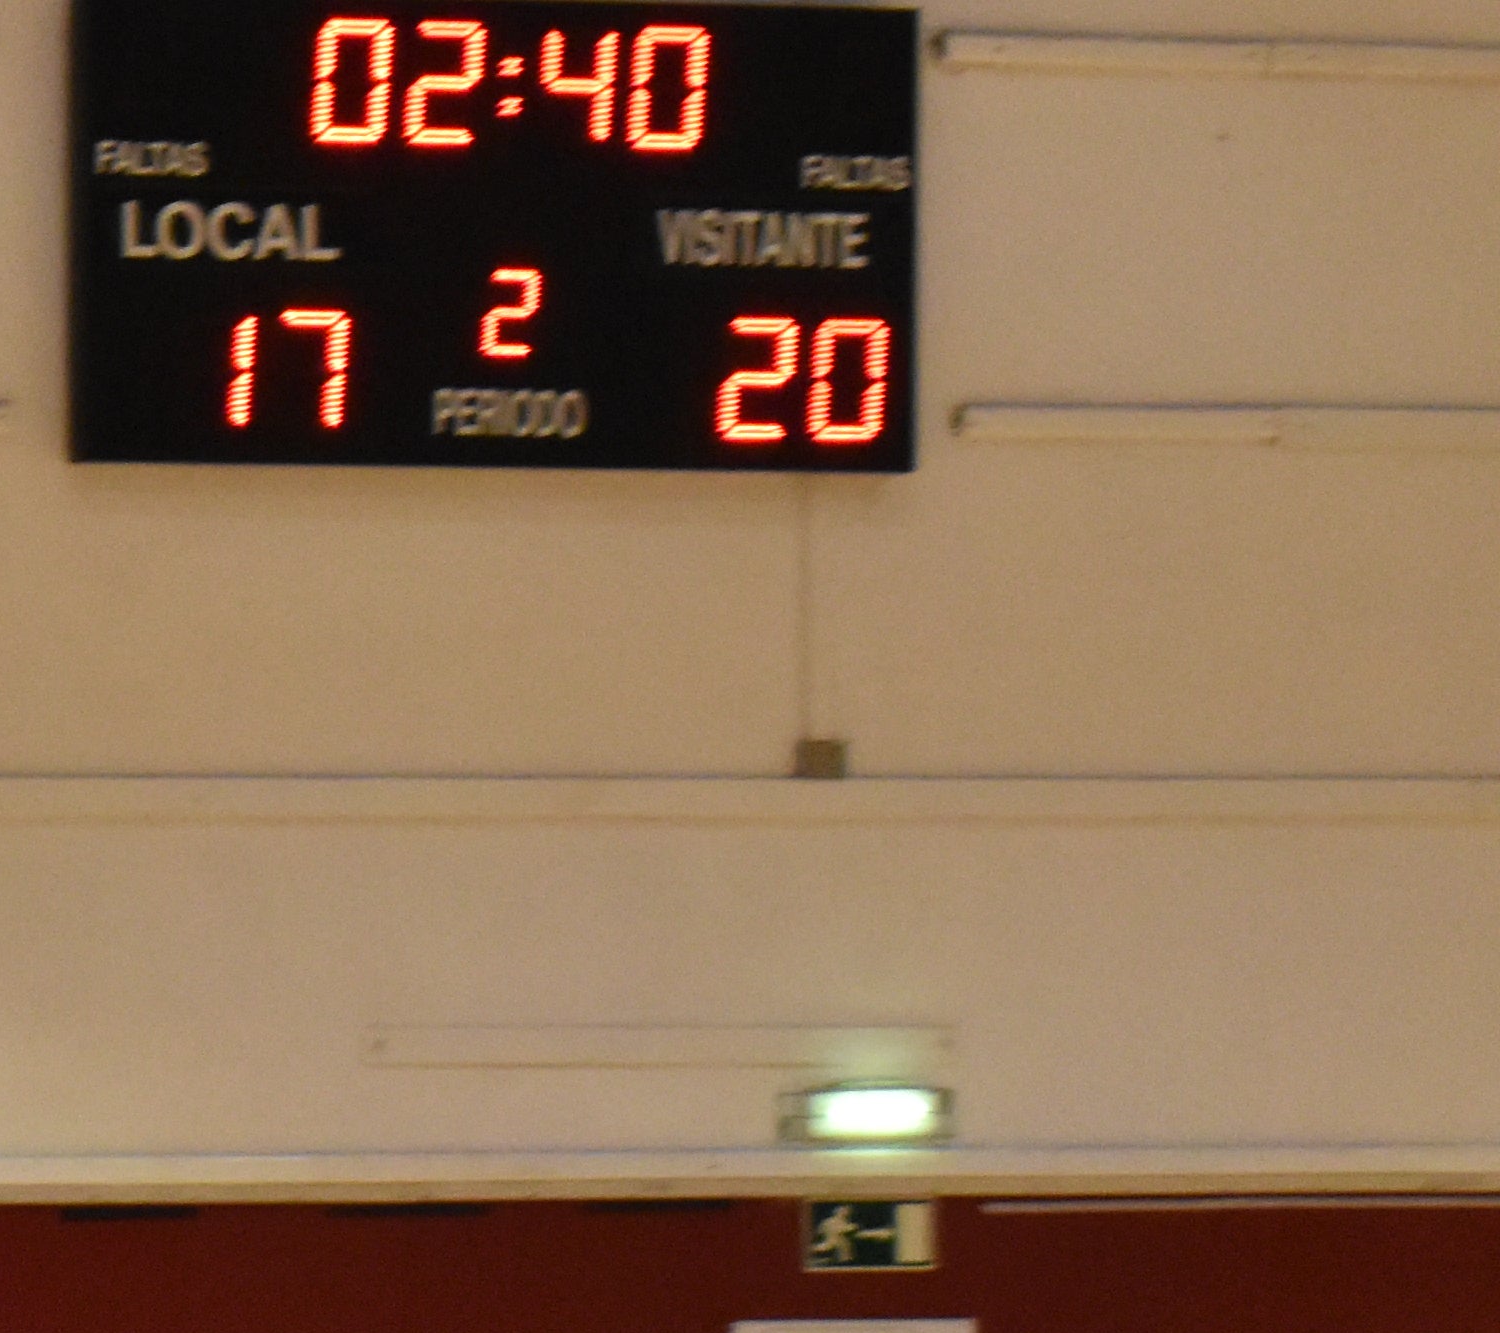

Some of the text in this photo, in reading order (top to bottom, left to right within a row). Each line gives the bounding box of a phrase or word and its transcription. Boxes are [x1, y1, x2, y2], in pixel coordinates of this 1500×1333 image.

[309, 17, 712, 150] 02:40
[95, 138, 211, 177] FALTAS
[801, 155, 912, 191] FALTAS
[121, 199, 344, 262] LOCAL
[657, 208, 871, 270] VISITANTE
[477, 267, 543, 359] 2
[225, 308, 353, 428] 17
[715, 316, 891, 441] 20
[432, 387, 589, 439] PERIODO
